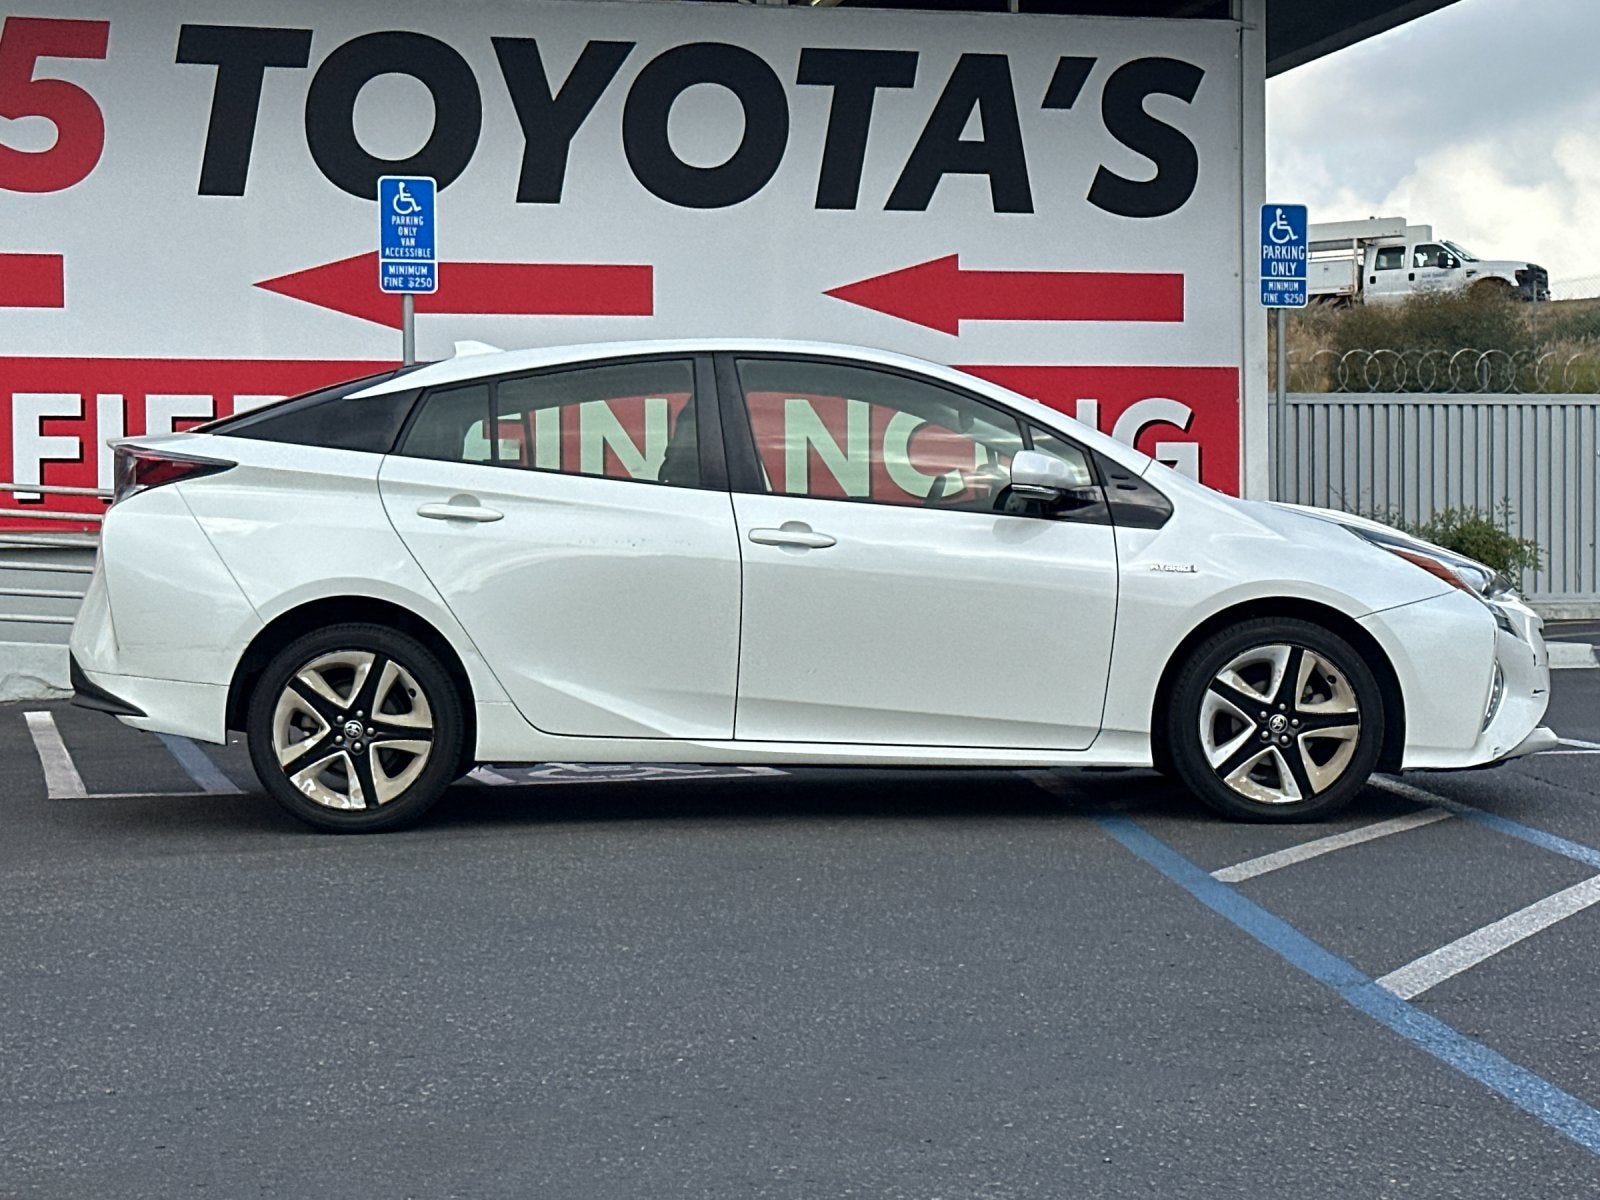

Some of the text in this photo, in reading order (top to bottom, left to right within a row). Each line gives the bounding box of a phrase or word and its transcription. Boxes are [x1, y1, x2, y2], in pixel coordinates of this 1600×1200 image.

[175, 24, 1206, 217] TOYOTA'S
[391, 215, 424, 226] PARKING
[398, 226, 417, 236] ONLY
[400, 237, 416, 246] VAN
[385, 247, 431, 258] ACCESSIBLE
[1262, 245, 1305, 260] PARKING
[388, 265, 428, 276] MINIMUM
[1271, 262, 1296, 276] ONLY
[384, 276, 432, 288] FINE $250
[1268, 282, 1298, 291] MINIMUM
[1264, 292, 1304, 304] FINE $250
